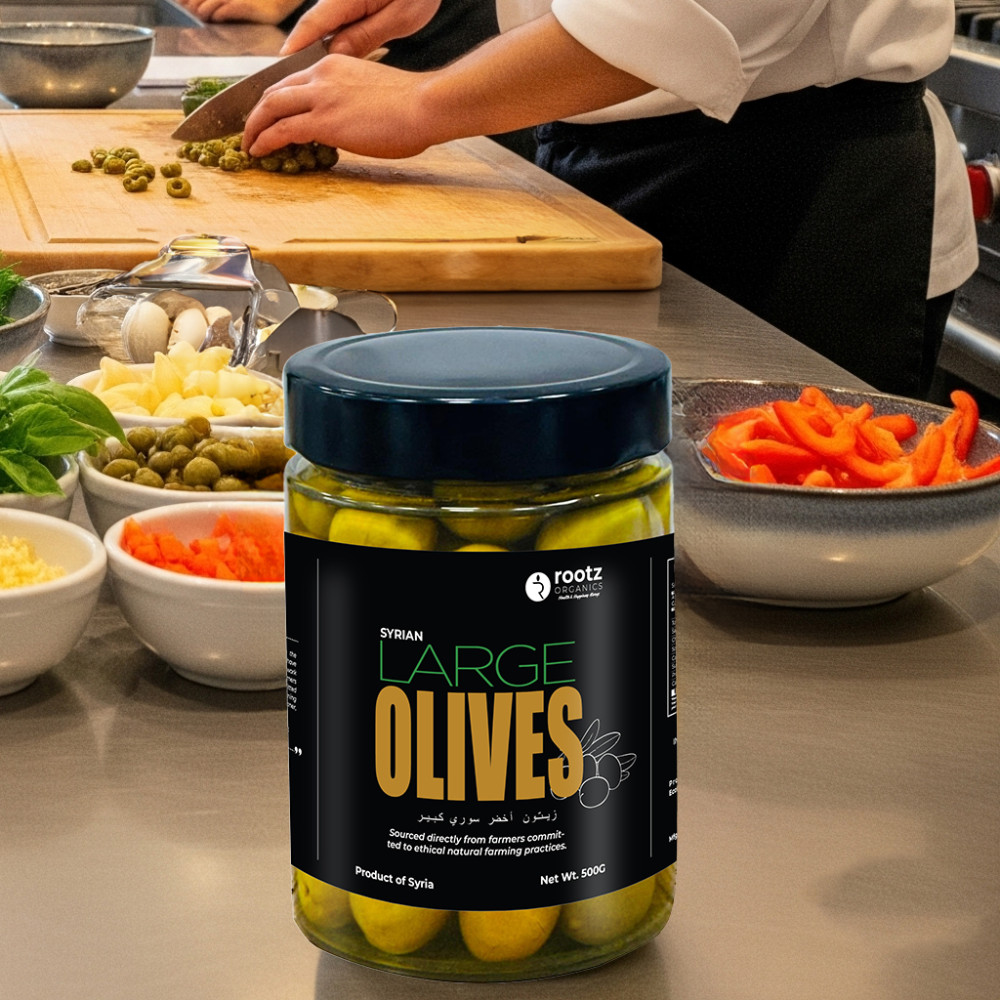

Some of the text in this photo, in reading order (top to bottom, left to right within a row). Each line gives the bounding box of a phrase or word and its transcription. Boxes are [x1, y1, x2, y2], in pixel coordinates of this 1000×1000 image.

[554, 565, 603, 585] rootz
[554, 582, 604, 595] ORGANICS
[380, 627, 424, 642] SYRIAN
[380, 640, 576, 687] LARGE
[375, 685, 584, 801] OLIVES
[417, 809, 558, 826] زيتون أخضر سوري كبير
[388, 828, 565, 846] Sourced directly from farmers commit-
[387, 840, 567, 857] ted to ethical natural farming practices.
[355, 865, 435, 890] Product of Syria
[540, 863, 606, 886] Net Wt. 500G
